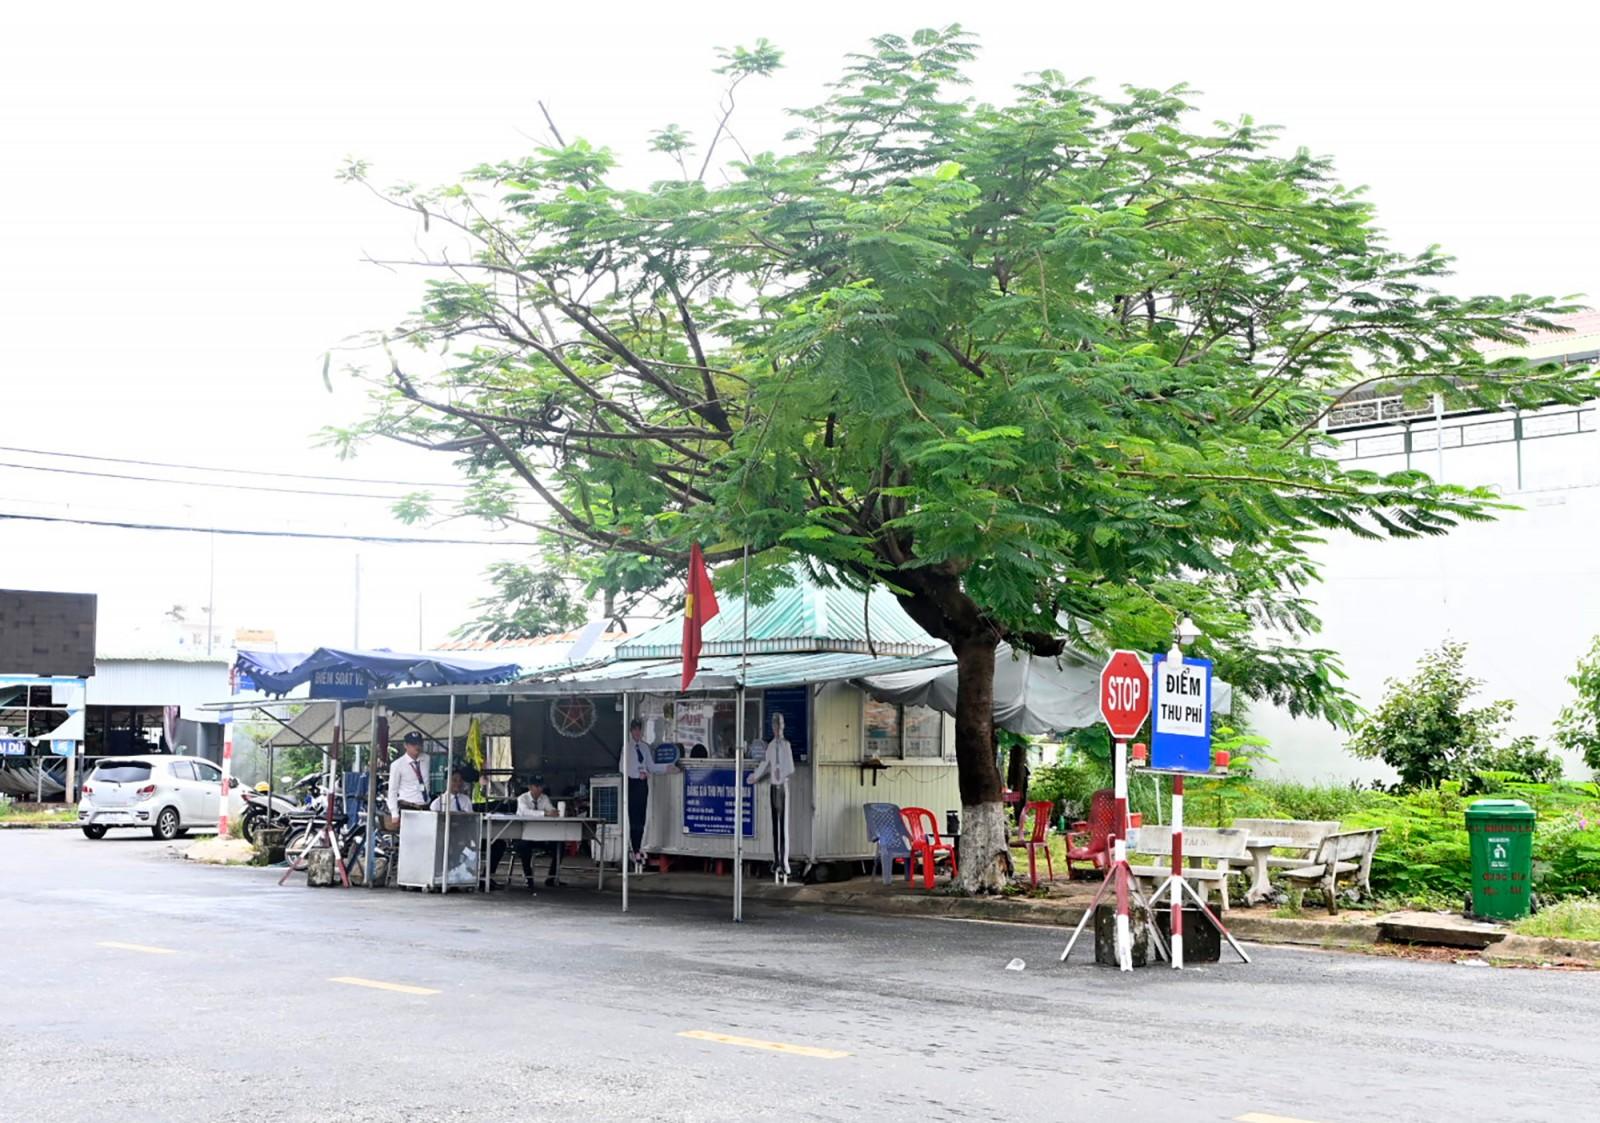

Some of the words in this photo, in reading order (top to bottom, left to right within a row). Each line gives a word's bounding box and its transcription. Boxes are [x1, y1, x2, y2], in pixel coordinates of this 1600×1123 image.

[1108, 675, 1141, 711] STOP
[1166, 667, 1201, 696] ĐIỂM
[1161, 704, 1182, 721] THU
[1185, 704, 1202, 723] PHÍ
